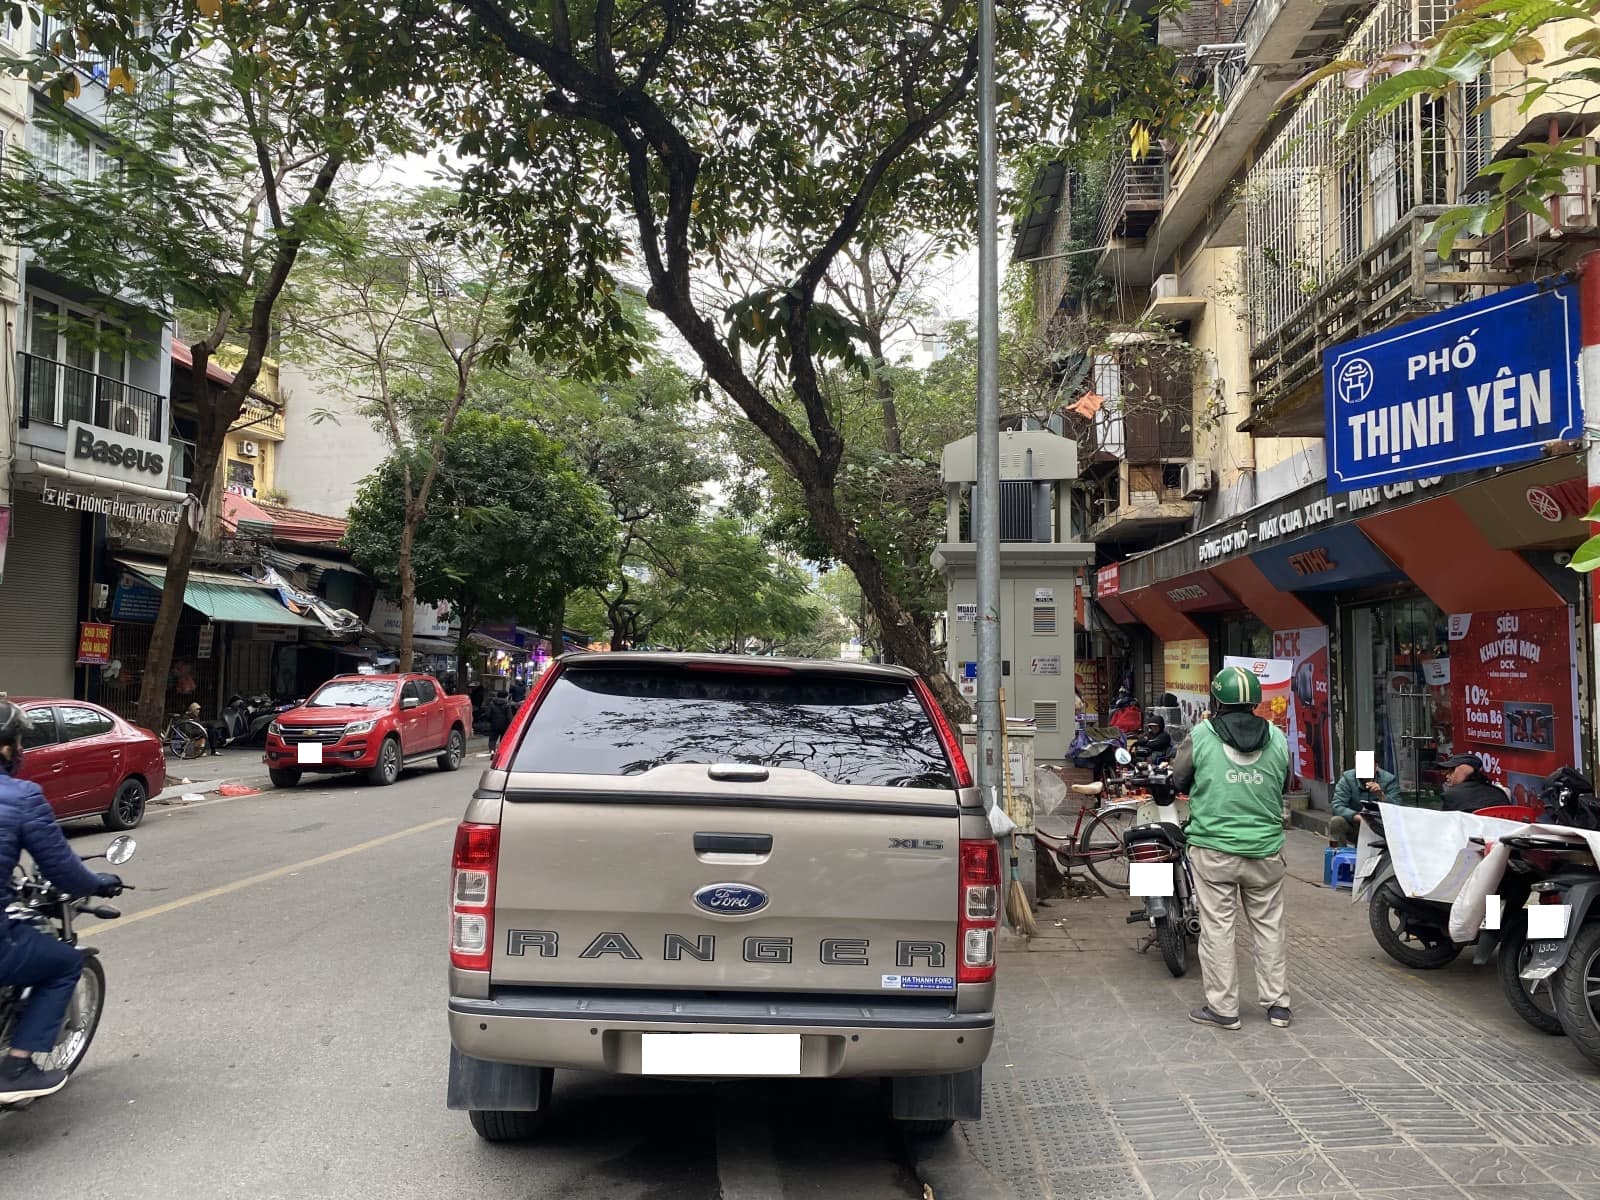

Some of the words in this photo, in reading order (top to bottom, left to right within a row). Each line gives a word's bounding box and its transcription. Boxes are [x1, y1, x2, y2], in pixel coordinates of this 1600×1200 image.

[1407, 328, 1480, 380] PHỐ
[1348, 391, 1453, 463] THỊNH
[1466, 366, 1551, 437] YÊN
[74, 426, 164, 475] Baseus
[1287, 547, 1338, 576] STIHL
[1496, 612, 1519, 634] SIÊU
[1479, 633, 1518, 663] KHUYẾN
[1464, 684, 1489, 706] 10%
[1225, 769, 1264, 785] Grab
[888, 837, 944, 849] XLS
[710, 888, 751, 907] Ford
[506, 929, 946, 968] RANGER
